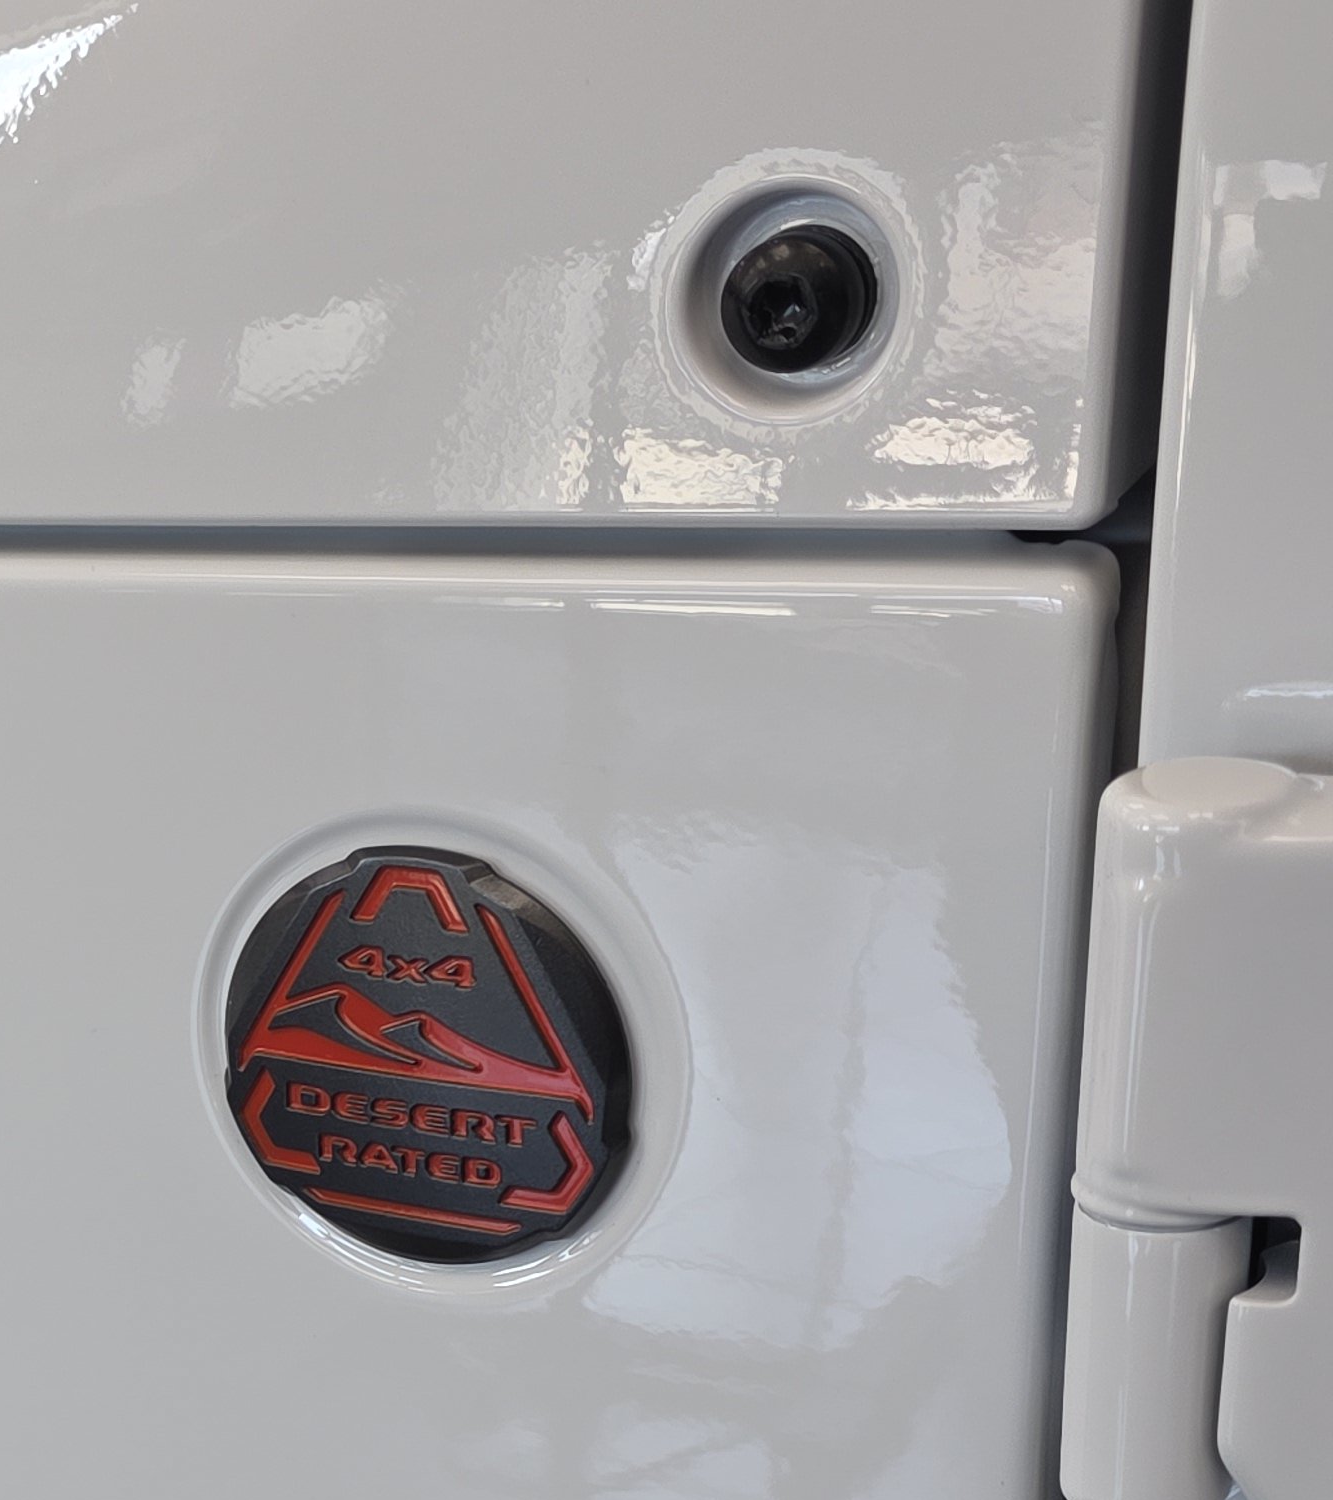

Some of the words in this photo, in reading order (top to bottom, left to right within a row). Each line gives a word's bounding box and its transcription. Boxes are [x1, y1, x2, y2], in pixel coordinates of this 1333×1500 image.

[339, 946, 476, 988] 4x4
[287, 1082, 536, 1147] DESERT
[319, 1134, 502, 1188] RATED
